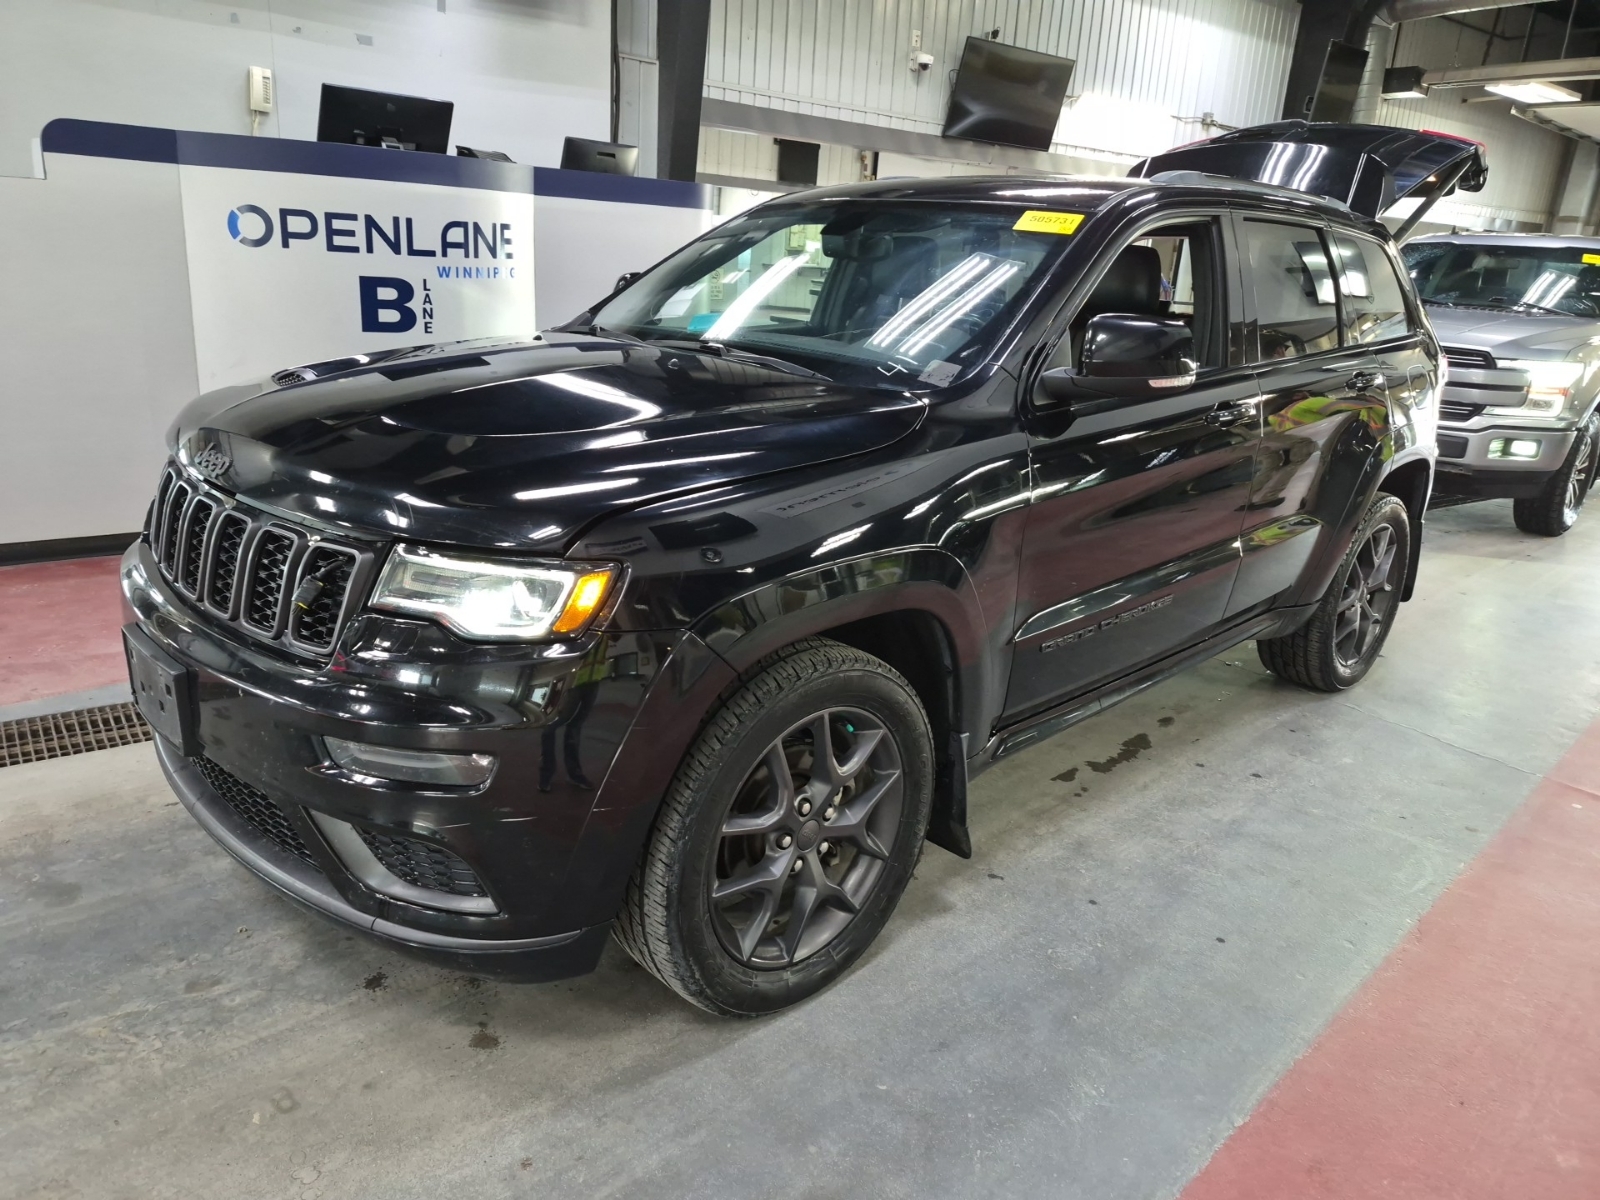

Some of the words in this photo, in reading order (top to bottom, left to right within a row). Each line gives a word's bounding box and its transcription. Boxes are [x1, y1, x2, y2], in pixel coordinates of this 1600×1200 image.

[227, 204, 514, 259] OPENLANE
[1029, 215, 1075, 225] 505731
[436, 265, 515, 278] WINNIPG
[358, 275, 418, 333] B
[422, 278, 434, 334] LANE
[194, 442, 232, 478] Jeep
[1041, 625, 1097, 653] GRAND
